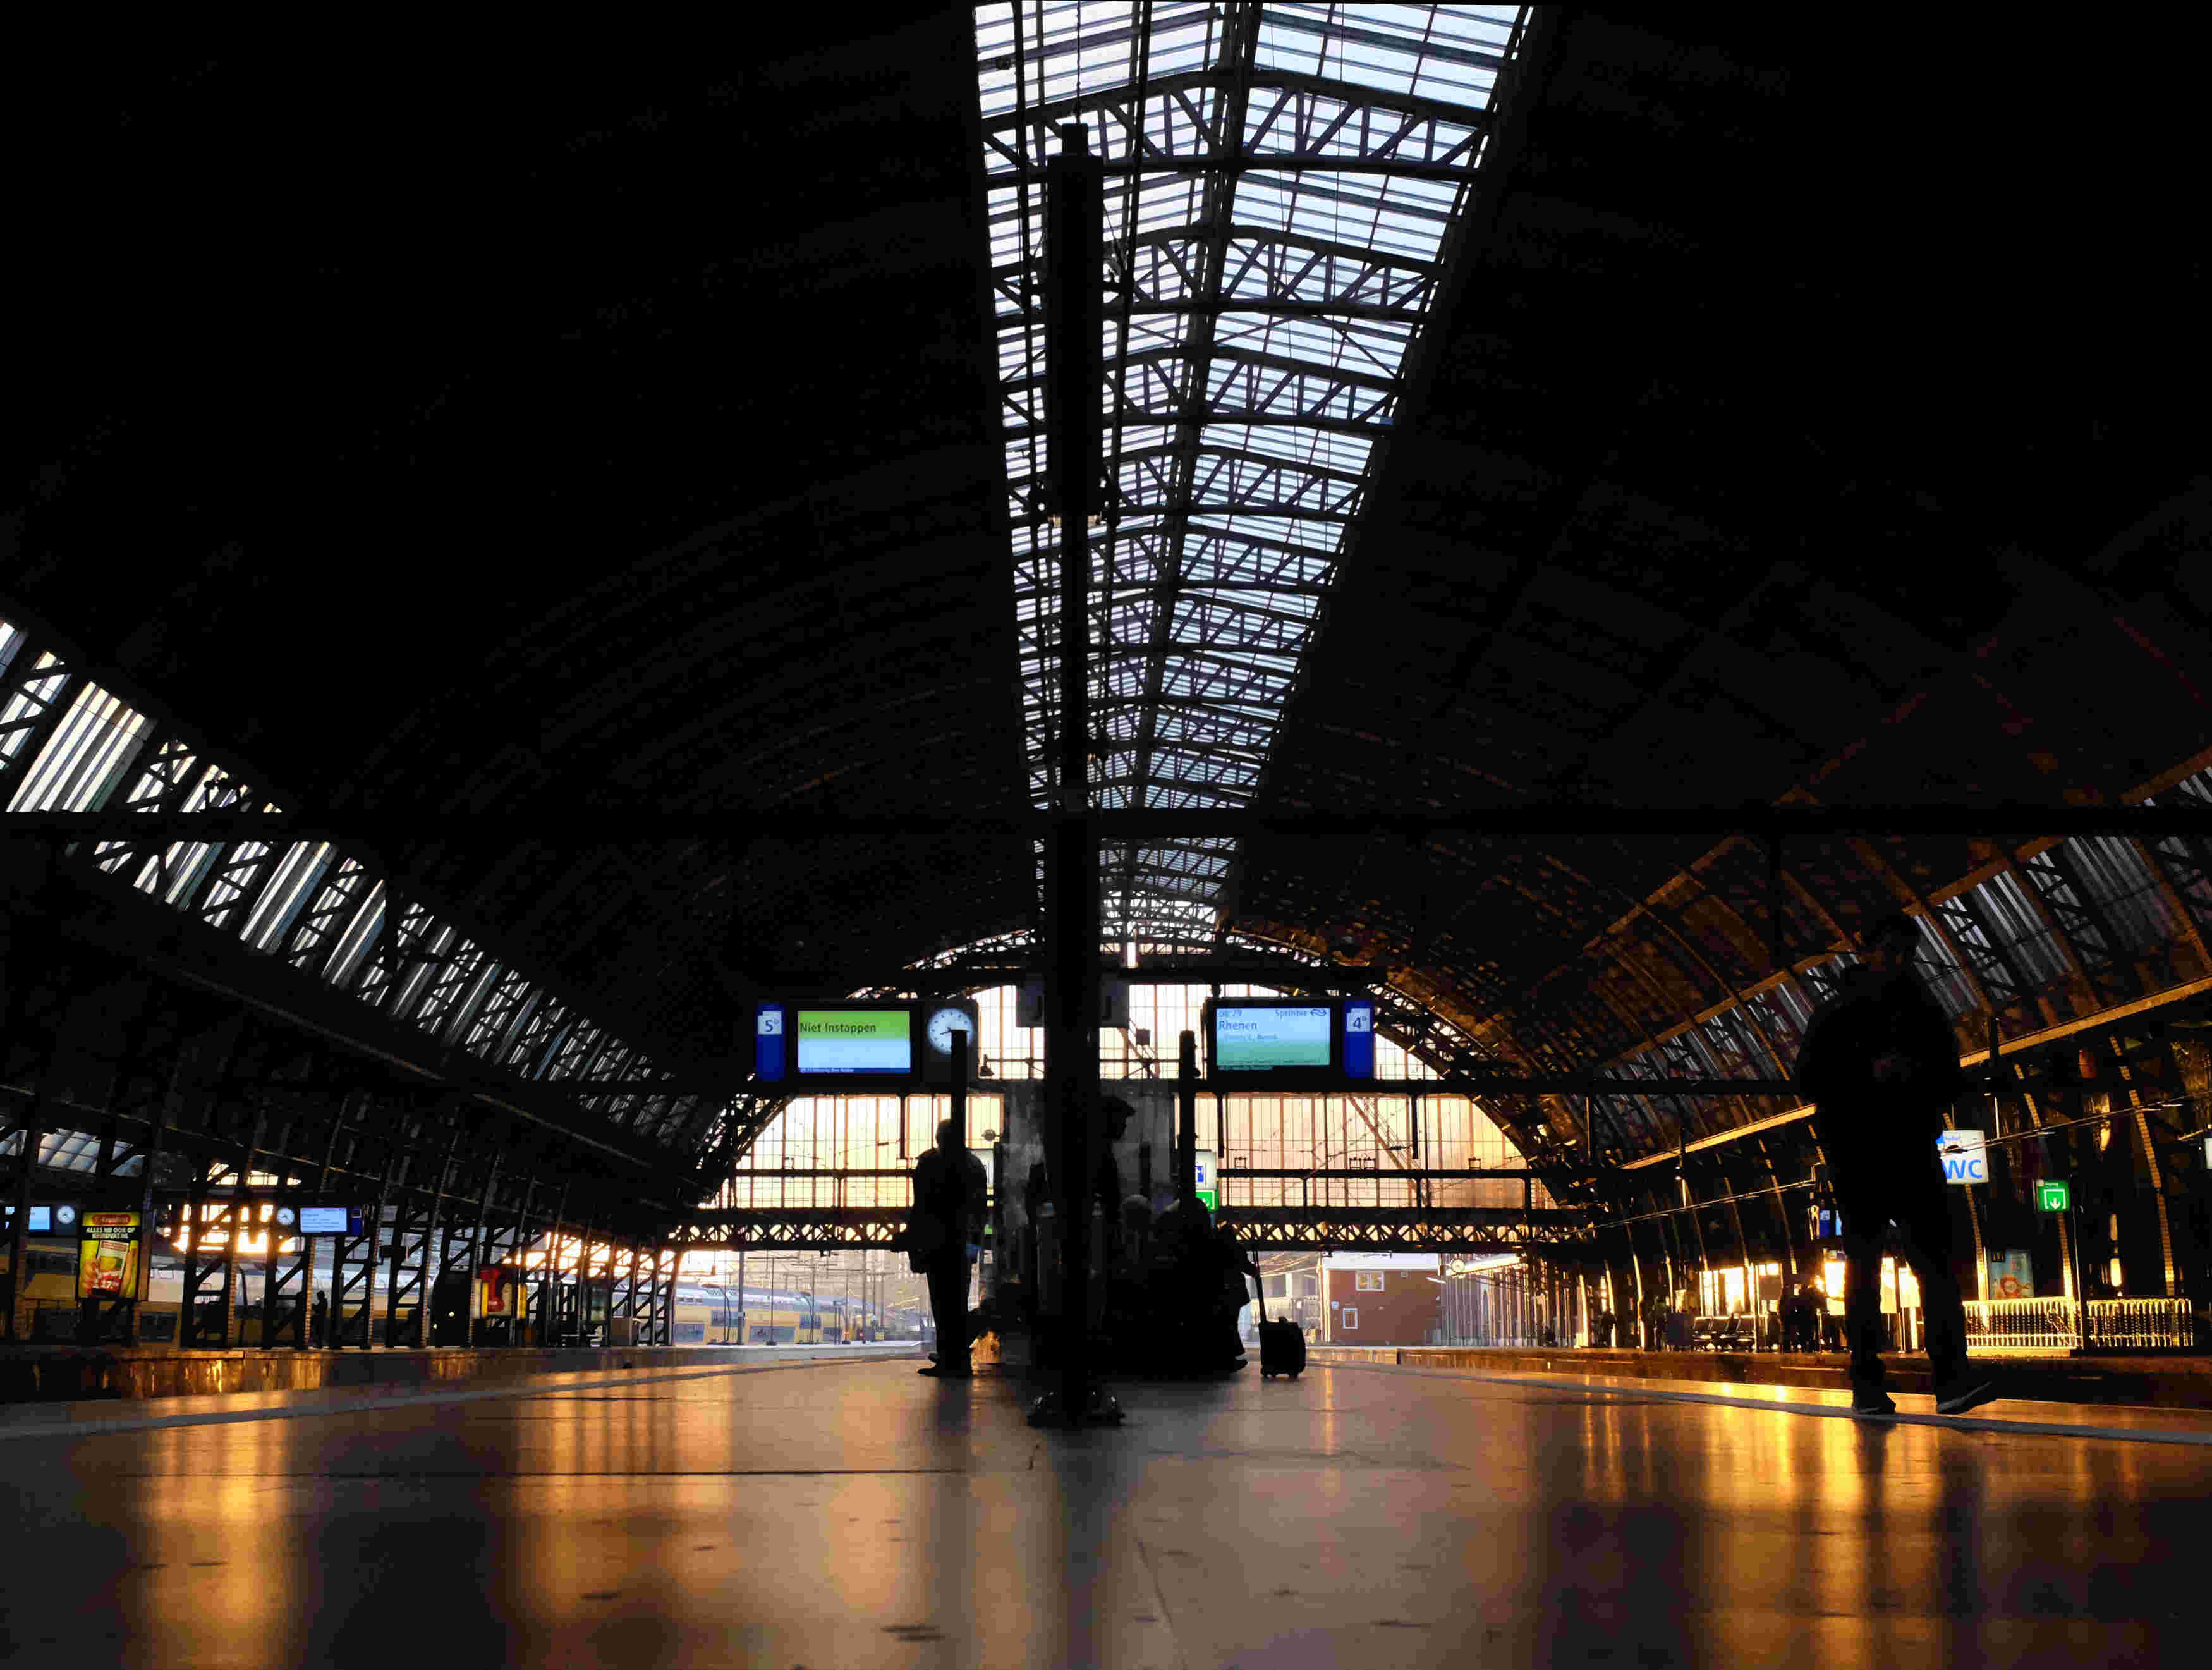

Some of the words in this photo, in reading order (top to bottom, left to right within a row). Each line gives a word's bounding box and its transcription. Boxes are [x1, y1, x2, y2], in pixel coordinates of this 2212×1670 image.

[799, 1022, 821, 1032] Niet
[1218, 1021, 1258, 1030] Rhenen
[1941, 1159, 1982, 1179] WC
